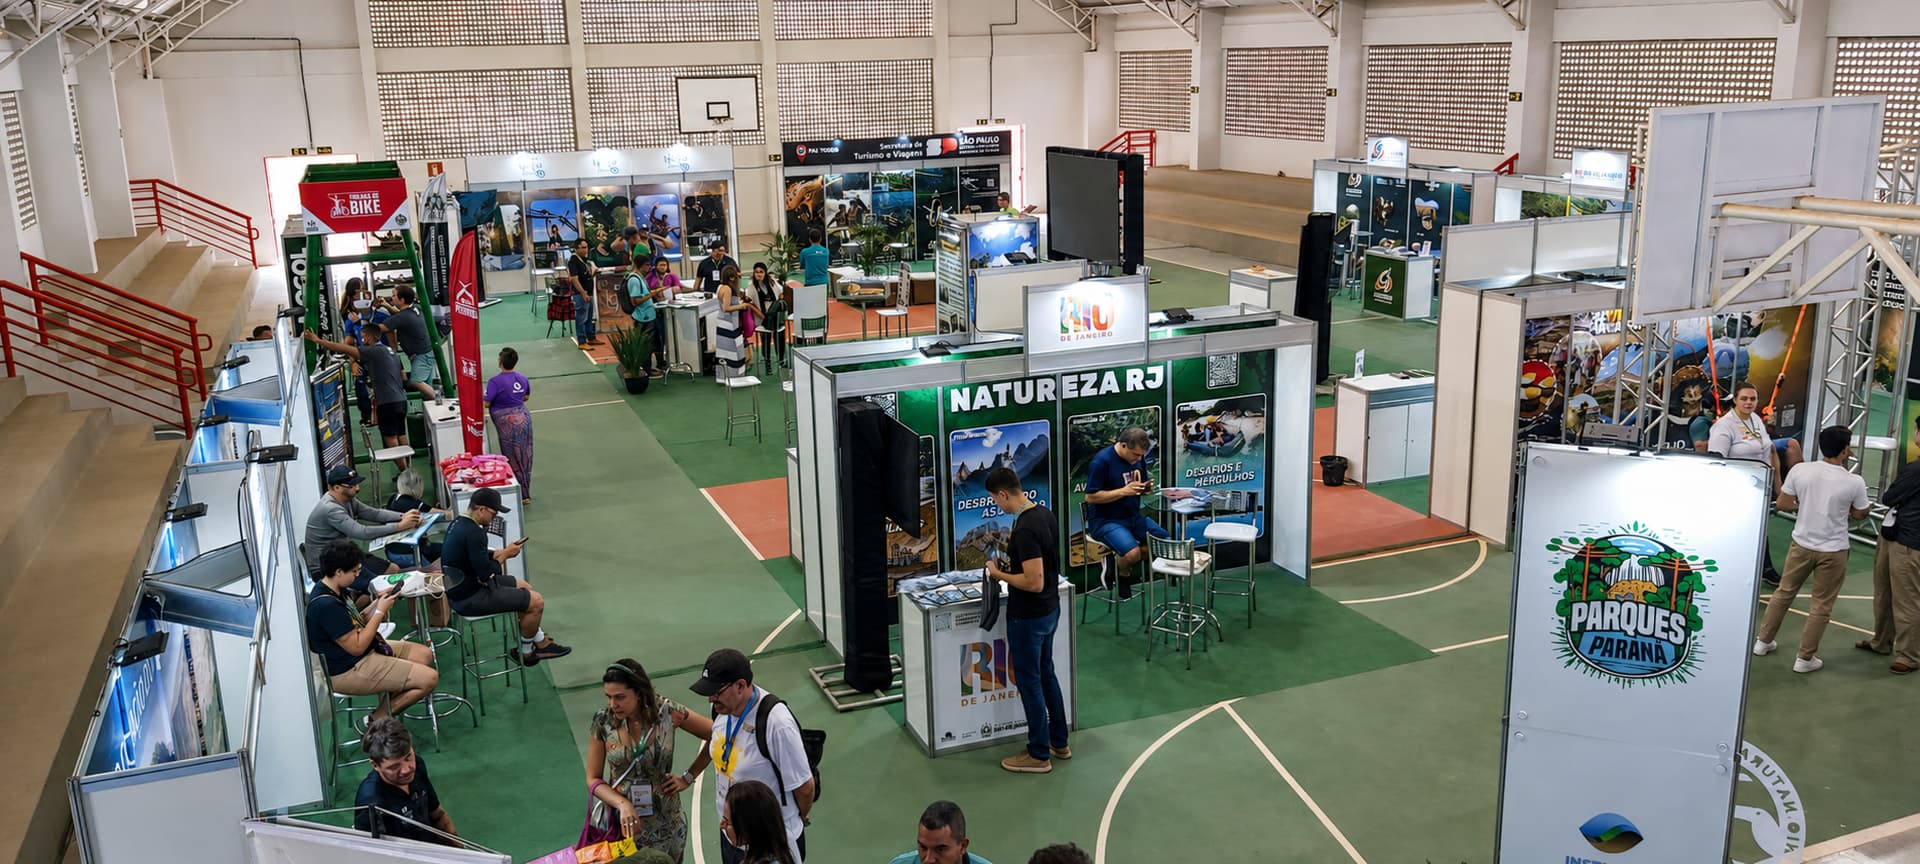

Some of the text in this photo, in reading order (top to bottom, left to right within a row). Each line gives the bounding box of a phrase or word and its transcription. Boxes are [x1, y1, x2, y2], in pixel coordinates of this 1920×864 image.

[914, 140, 922, 148] de
[976, 135, 1000, 144] PAULO
[853, 151, 885, 160] Turismo
[892, 149, 923, 159] Viagens
[350, 199, 382, 215] BIKE
[1076, 331, 1113, 341] JANEIRO
[950, 365, 1165, 413] NATUREZA RJ
[1185, 461, 1242, 478] DESAFIOS E
[1194, 471, 1255, 487] MERGULHOS
[1570, 600, 1687, 645] PARQUES
[960, 639, 1016, 697] RI
[961, 697, 978, 707] DE
